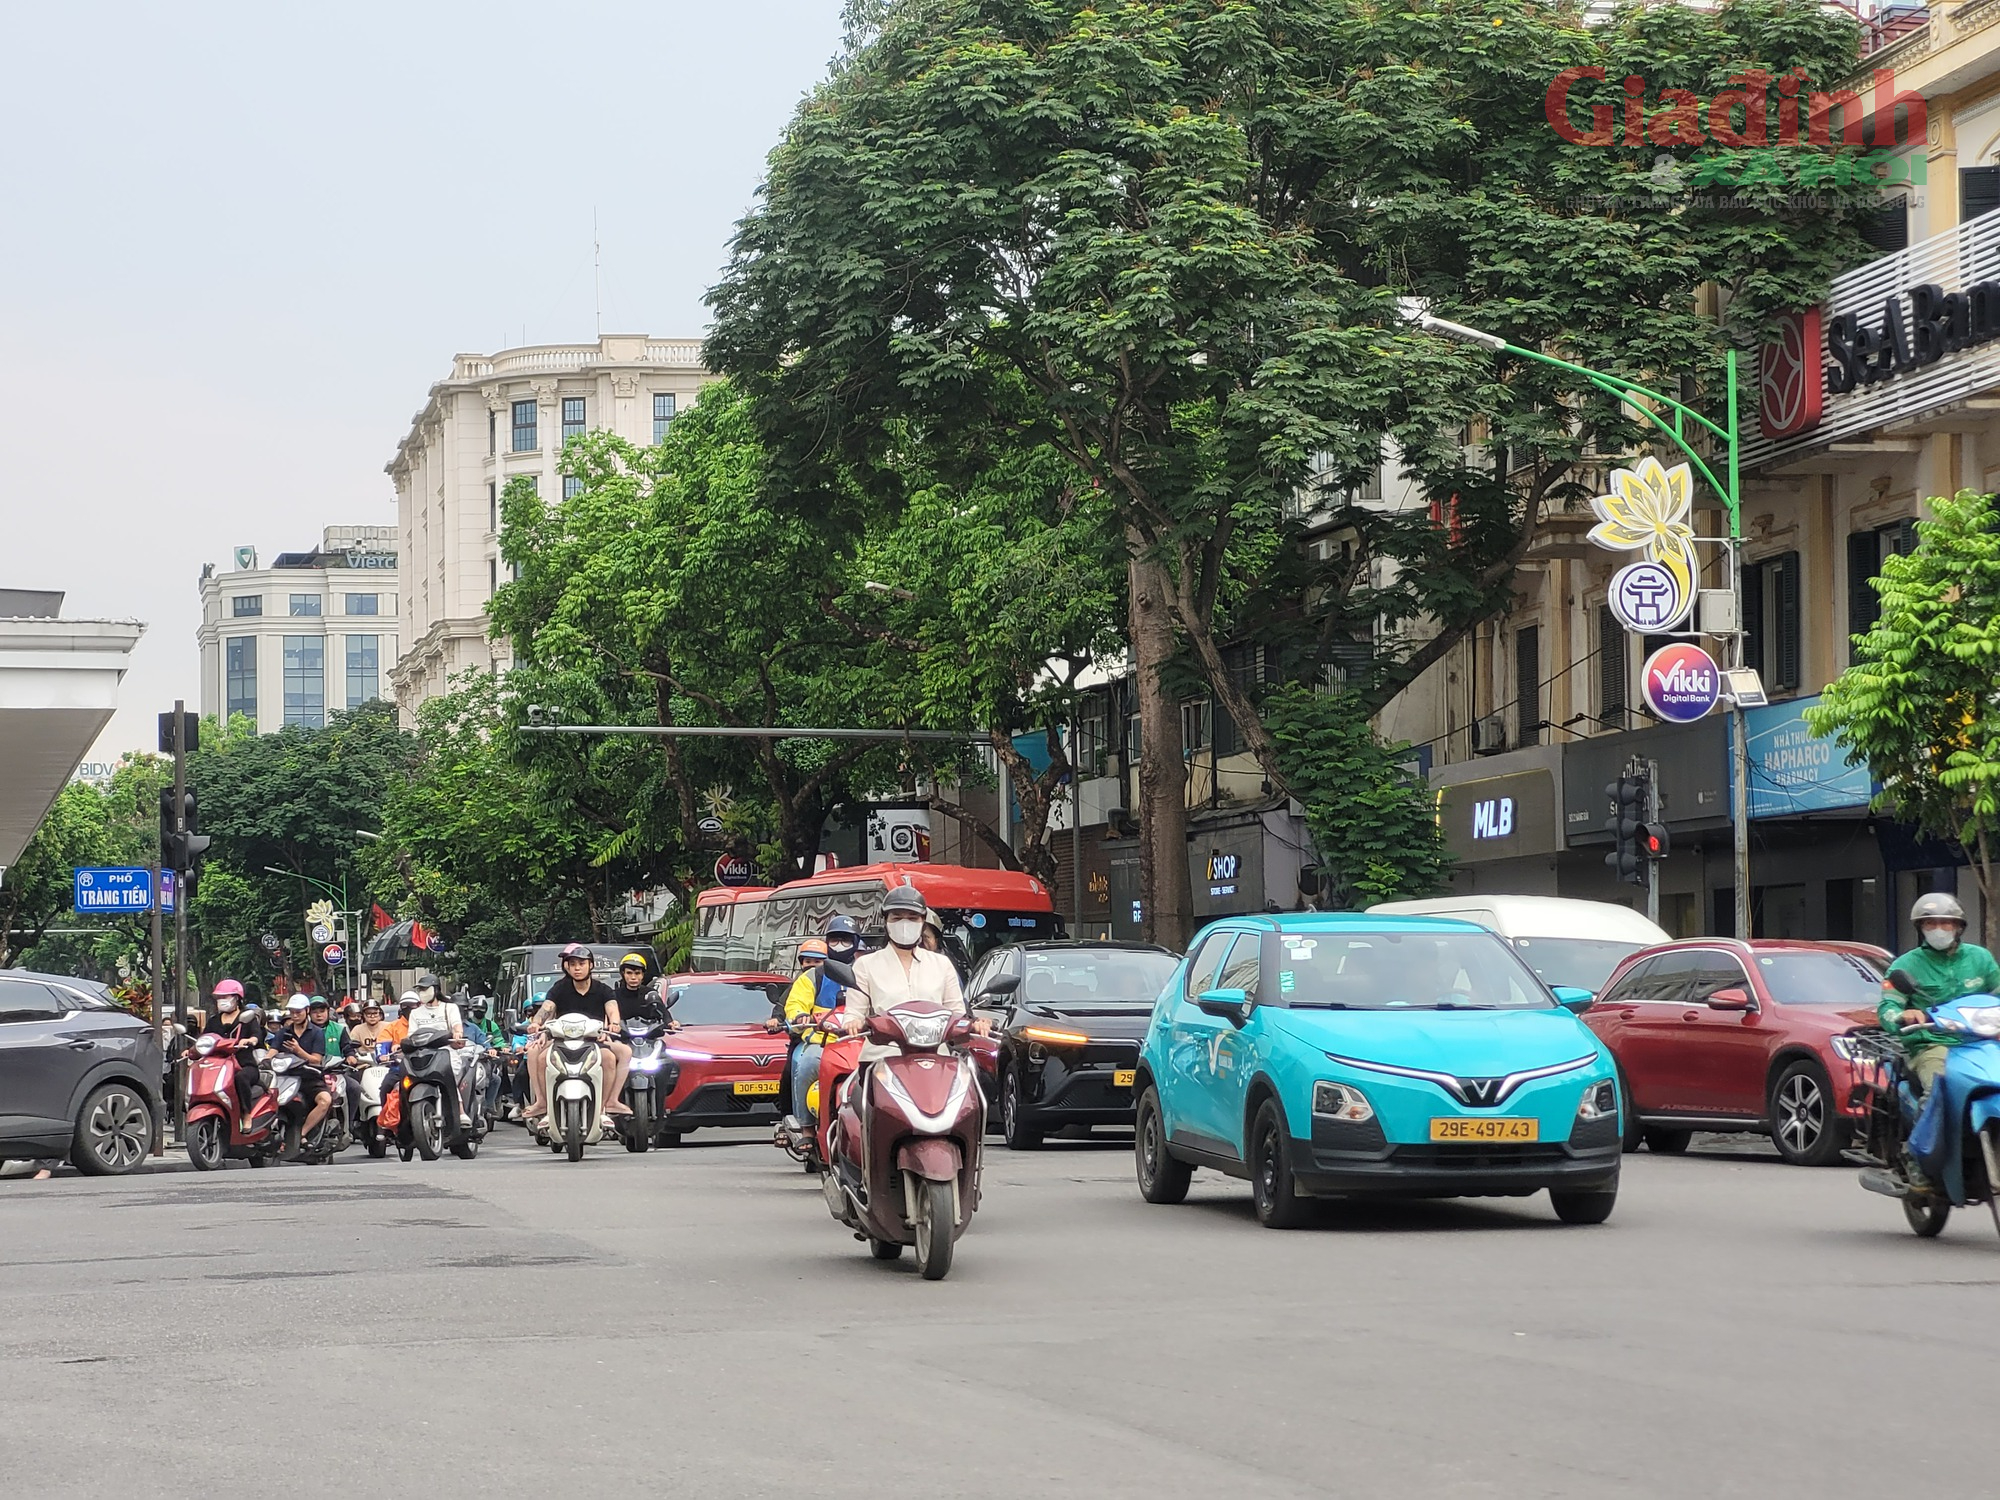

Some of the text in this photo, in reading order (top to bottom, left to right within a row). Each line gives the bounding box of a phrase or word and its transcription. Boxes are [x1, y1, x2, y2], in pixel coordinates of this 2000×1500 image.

[1828, 281, 2000, 394] SeABan
[1652, 658, 1710, 692] Vikki
[1663, 694, 1710, 703] Digital Bank
[1774, 729, 1790, 748] NHÀ
[1764, 743, 1830, 773] HAPHARCO
[79, 762, 114, 776] BIDV
[1776, 767, 1819, 786] PHARMACY
[1473, 797, 1512, 839] MLB
[719, 859, 748, 875] Vikki
[109, 871, 133, 883] PHỐ
[82, 887, 119, 905] TRÀNG
[122, 884, 147, 905] TIỀN
[1440, 1122, 1530, 1138] 29E-497.43
